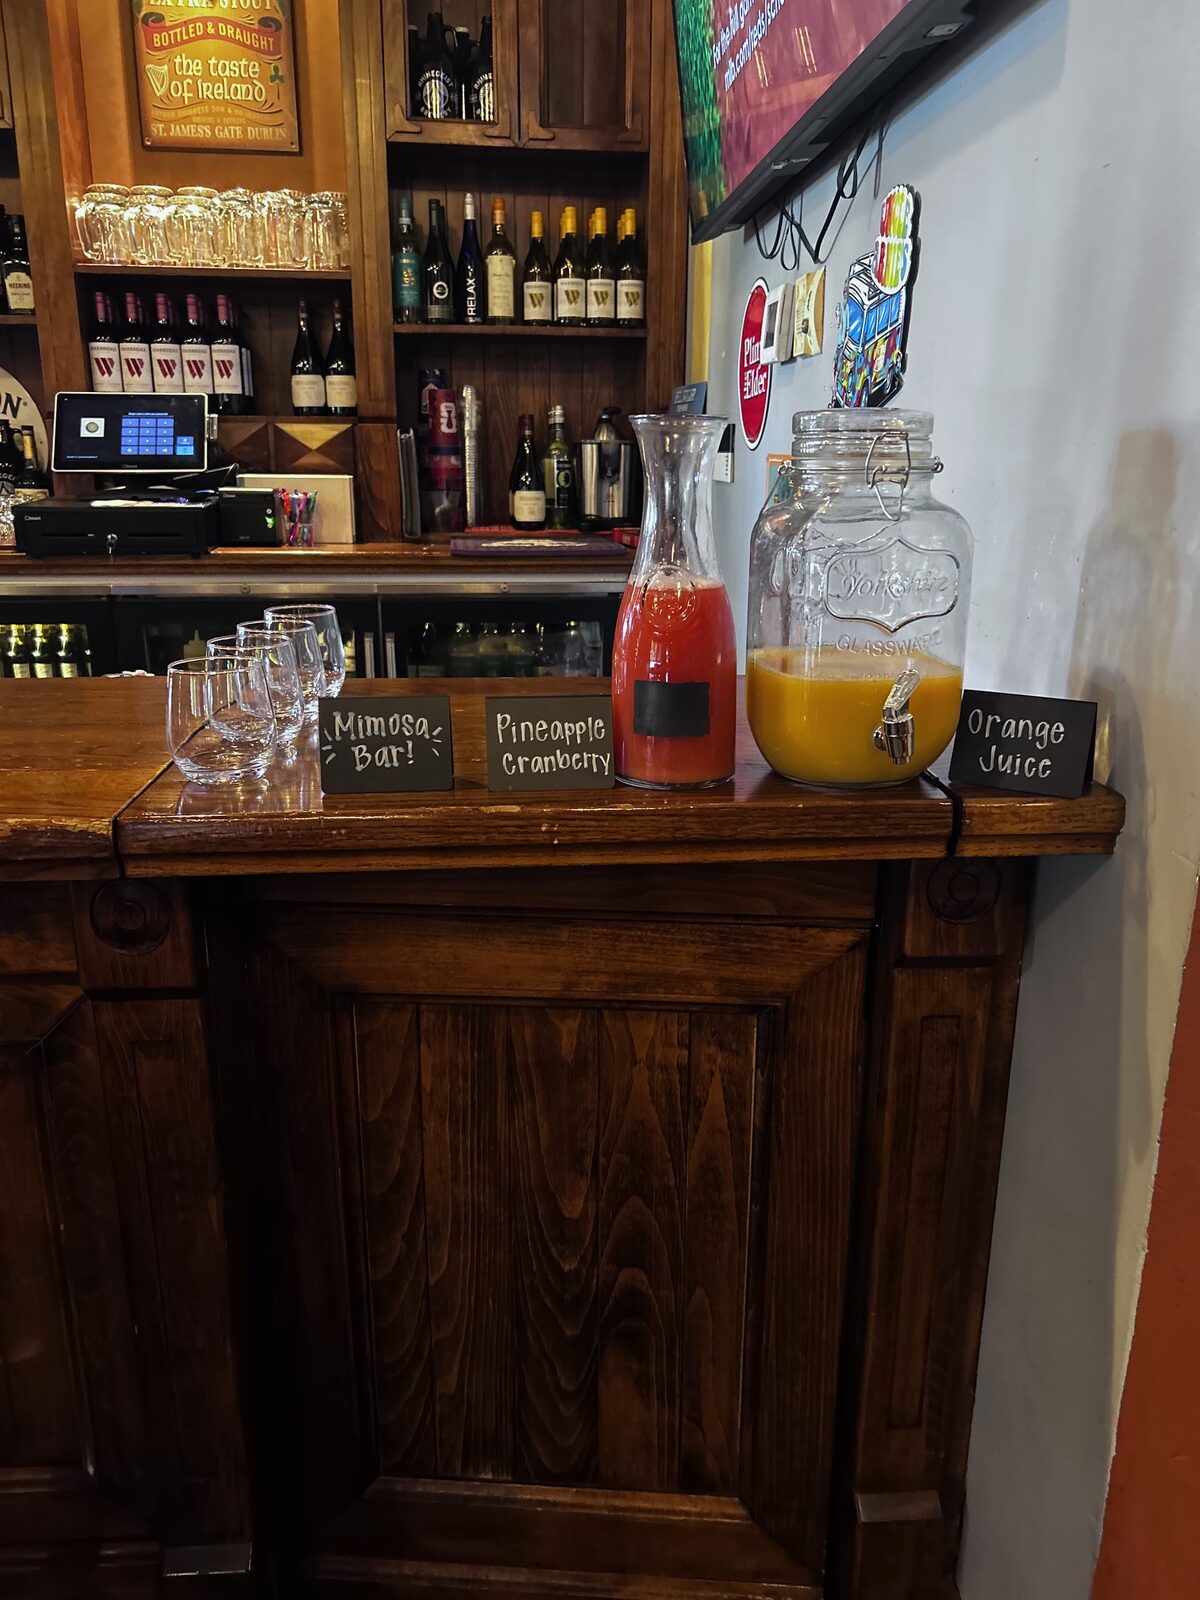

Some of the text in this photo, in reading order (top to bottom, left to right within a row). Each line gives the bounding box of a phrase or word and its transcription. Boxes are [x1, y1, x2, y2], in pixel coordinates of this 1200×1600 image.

[153, 21, 275, 52] BOTTLED & DRAUGHT
[173, 53, 260, 78] the taste
[170, 79, 193, 105] of
[151, 123, 167, 137] ST.
[214, 125, 243, 139] GATE
[247, 126, 287, 141] DUBLIN
[466, 277, 477, 316] RELAX
[744, 336, 761, 368] Plin
[746, 364, 767, 400] Elder
[0, 391, 22, 419] N
[836, 630, 944, 657] GLASSWARE
[332, 711, 430, 741] Mimosa
[496, 713, 606, 746] Pineapple
[968, 708, 1065, 750] Orange
[351, 740, 414, 772] Bar!
[502, 749, 611, 776] Cranberry
[979, 745, 1052, 778] Juice
